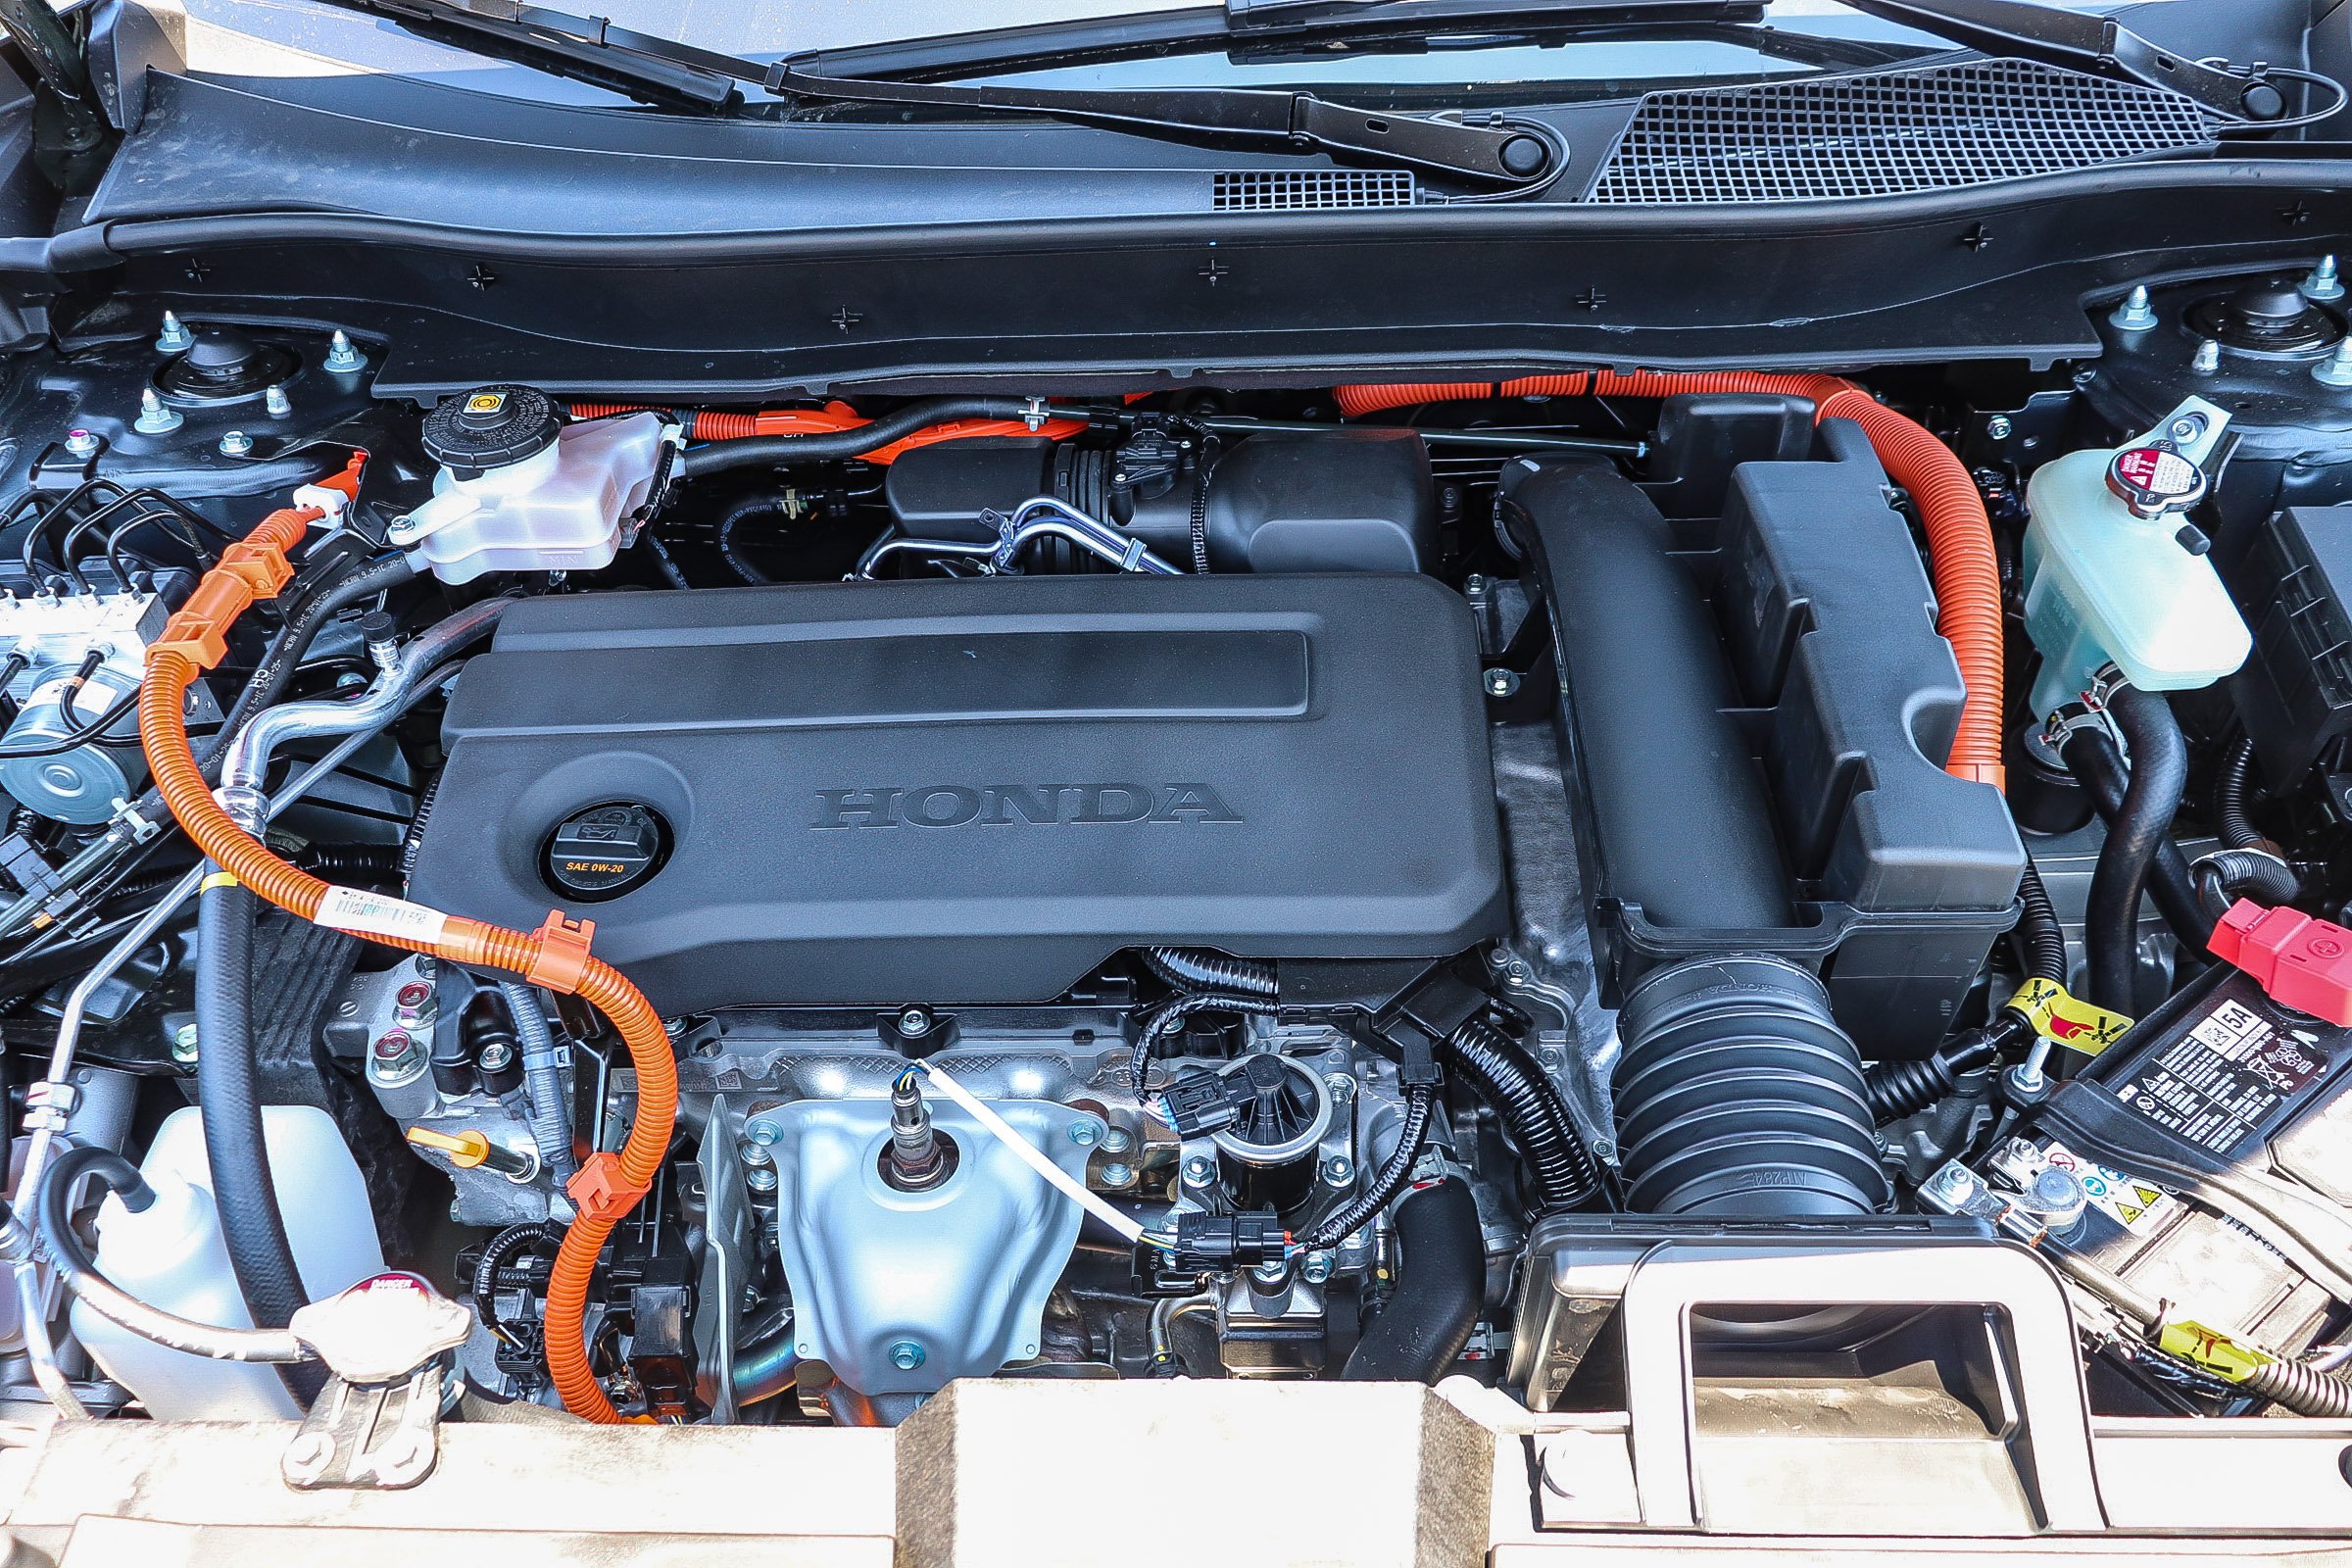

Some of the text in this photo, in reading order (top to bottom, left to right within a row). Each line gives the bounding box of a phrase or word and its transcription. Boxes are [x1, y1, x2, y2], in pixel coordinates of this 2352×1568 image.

[809, 784, 1244, 830] HONDA
[565, 862, 624, 873] SAE 0W-20
[2222, 1006, 2252, 1029] 5A
